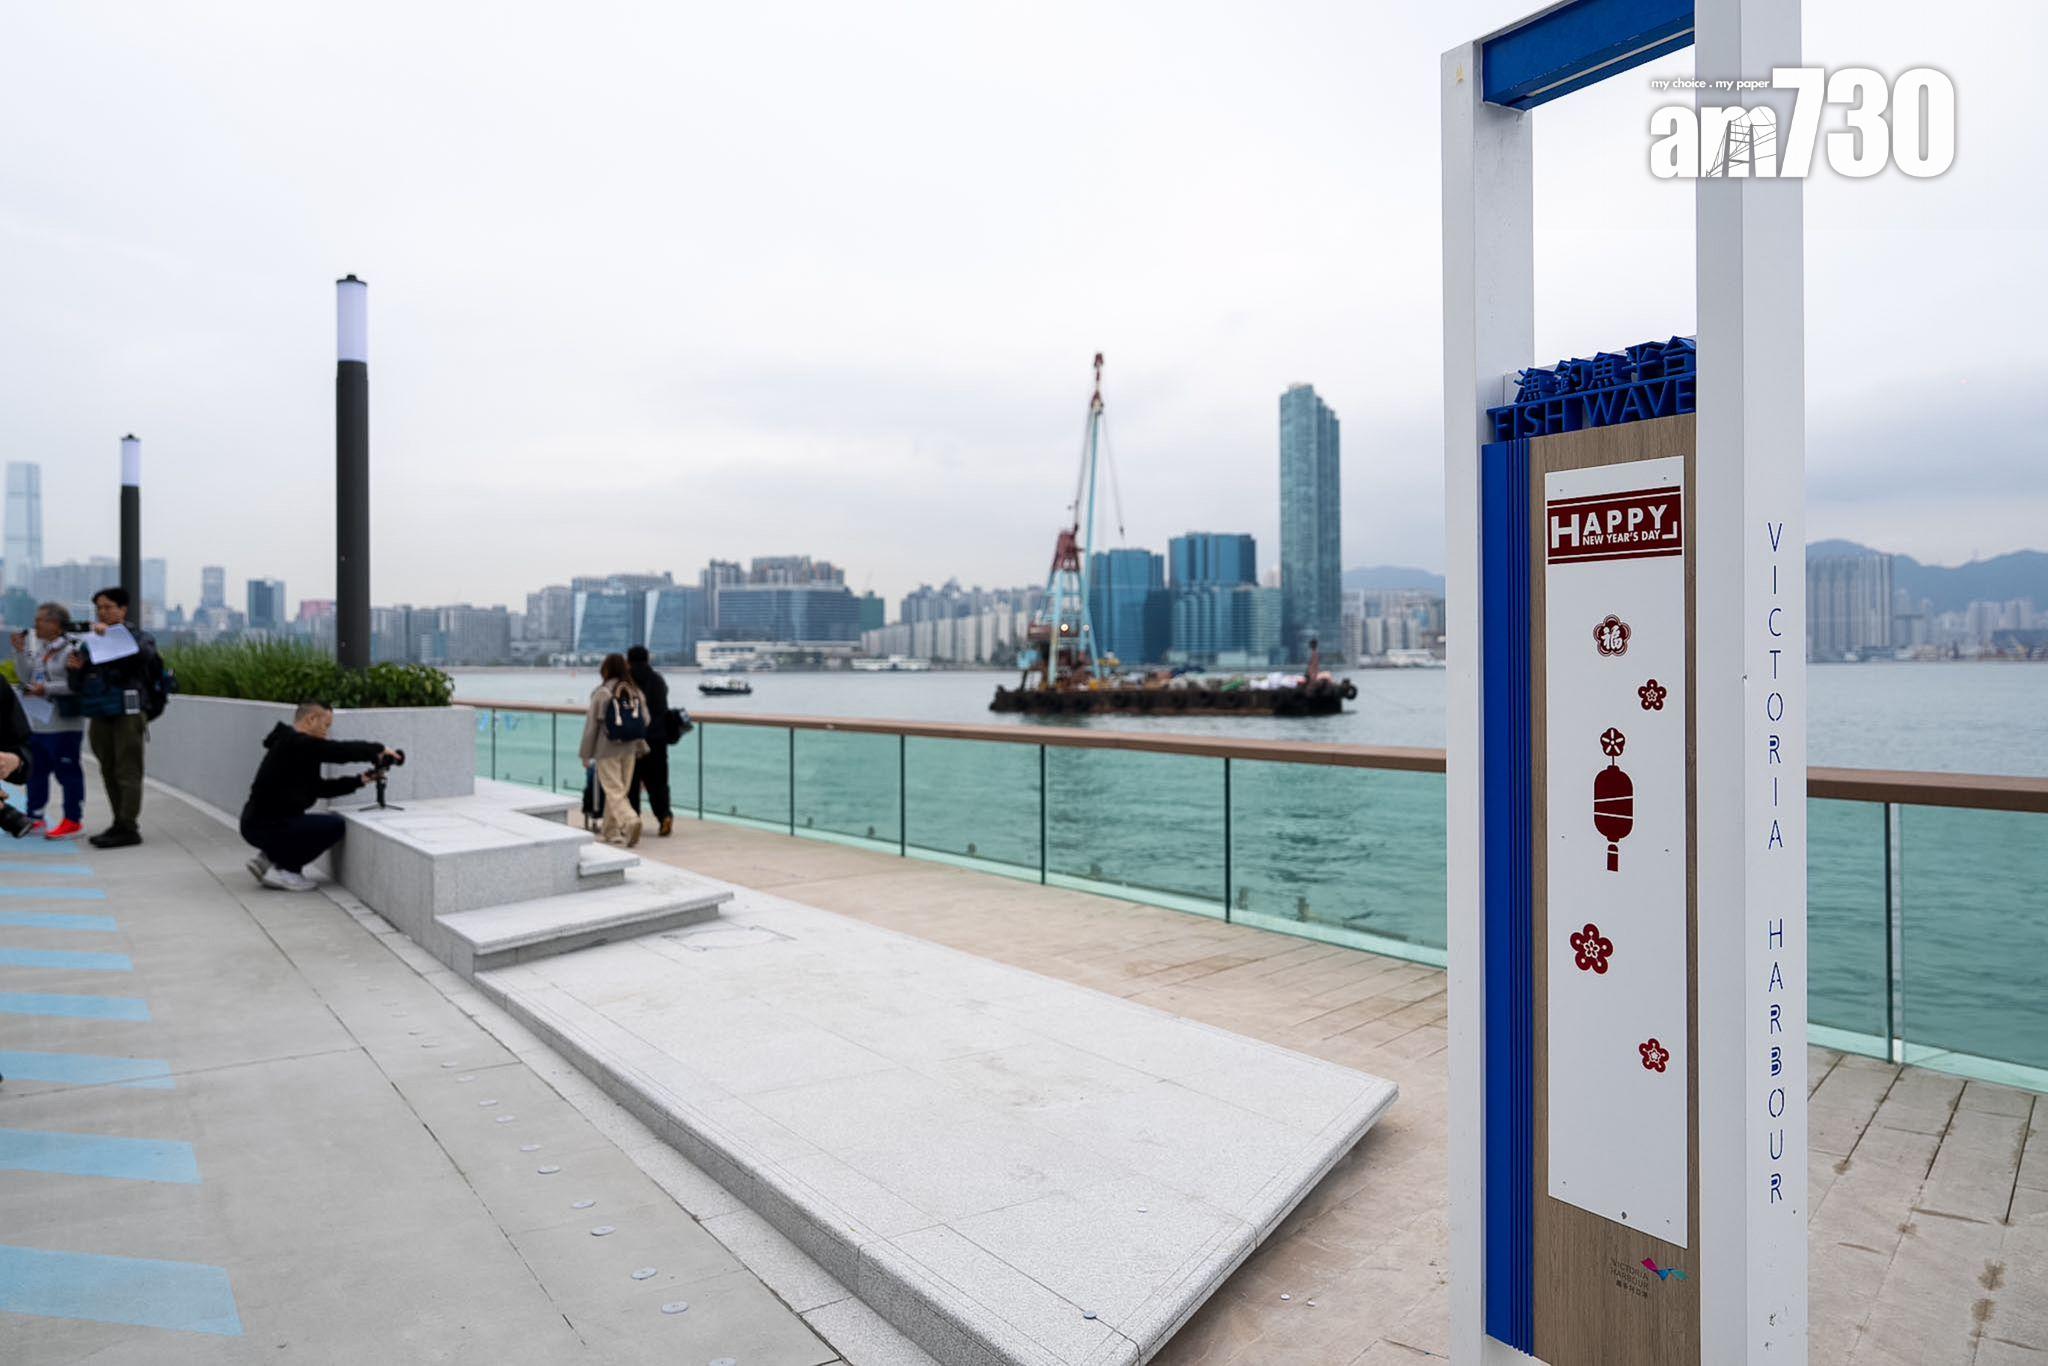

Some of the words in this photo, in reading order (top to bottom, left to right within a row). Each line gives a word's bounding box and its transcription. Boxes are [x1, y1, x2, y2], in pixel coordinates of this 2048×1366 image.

[1494, 400, 1567, 443] FISH
[1583, 376, 1696, 427] WAVE
[1550, 504, 1667, 548] HAPPY
[1582, 534, 1604, 546] NEW
[1606, 531, 1639, 544] YEAR'S
[1641, 529, 1661, 541] DAY
[1601, 624, 1623, 650] 福
[1767, 522, 1784, 850] VICTORIA
[1768, 918, 1785, 1204] HARBOUR
